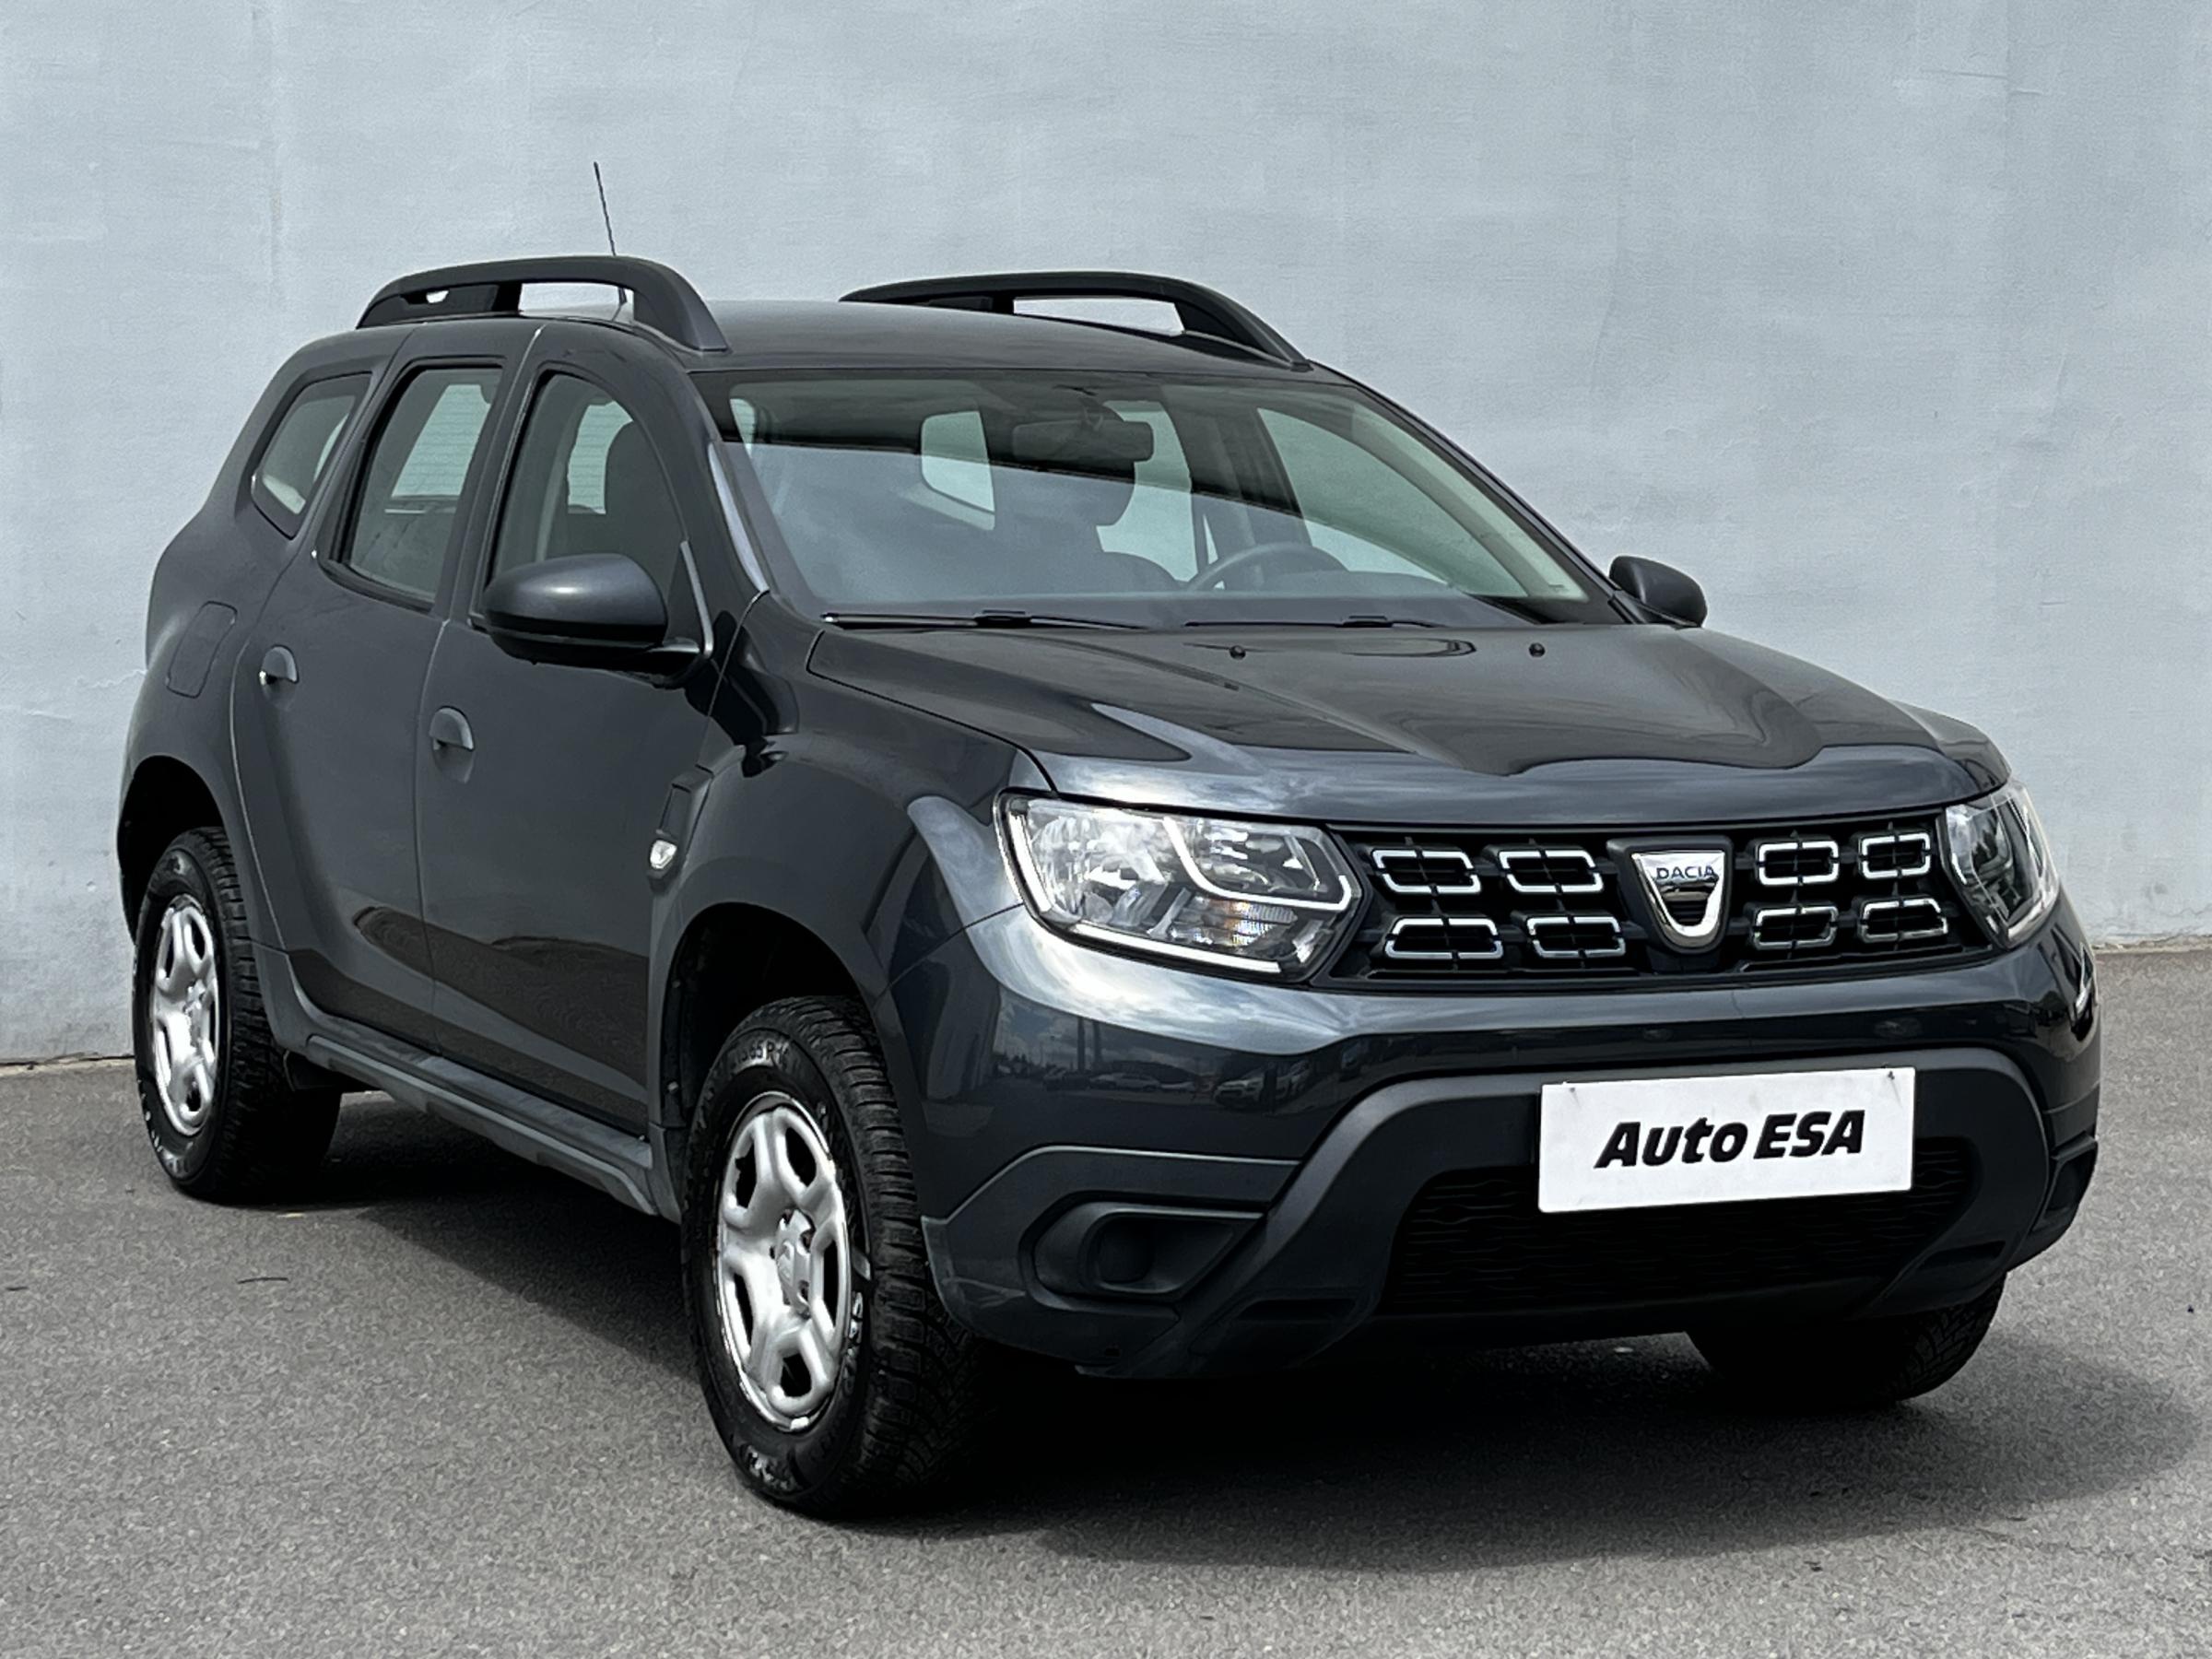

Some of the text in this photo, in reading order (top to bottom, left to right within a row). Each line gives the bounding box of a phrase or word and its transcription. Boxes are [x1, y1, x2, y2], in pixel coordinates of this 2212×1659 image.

[1656, 865, 1716, 880] DACIA
[1594, 1109, 1865, 1169] Auto ESA
